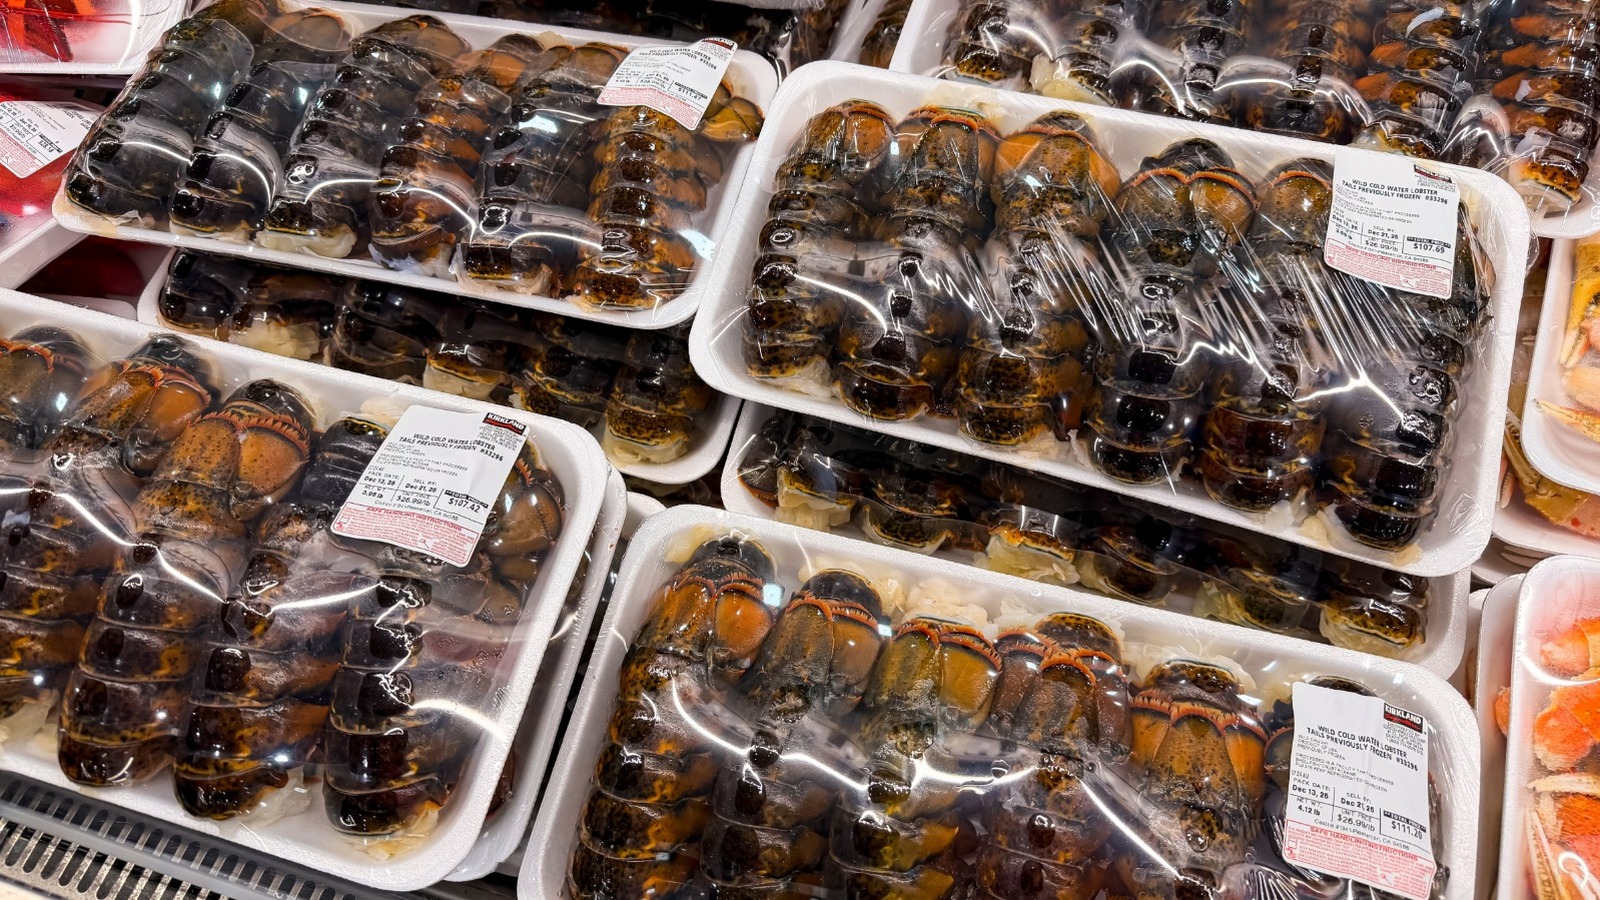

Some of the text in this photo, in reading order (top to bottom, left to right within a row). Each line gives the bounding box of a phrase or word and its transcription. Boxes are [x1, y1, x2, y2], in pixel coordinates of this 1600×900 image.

[691, 50, 711, 61] LOBSTER
[1342, 180, 1357, 190] TAILS
[1358, 186, 1396, 197] PREVIOUSLY
[1396, 192, 1421, 200] FROZEN
[1425, 195, 1448, 205] #33296
[1352, 179, 1438, 196] WILD COLD WATER LOBSTER
[1413, 243, 1445, 254] $107.69
[488, 412, 524, 430] KIRKLAND
[399, 436, 416, 445] TAILS
[416, 440, 454, 449] PREVIOUSLY
[453, 443, 478, 451] FROZEN
[480, 448, 504, 462] #33296
[413, 433, 430, 441] WILD
[447, 437, 469, 445] WATER
[469, 439, 496, 451] LOBSTER
[363, 475, 377, 483] Dec
[448, 498, 481, 514] $107.42
[415, 512, 462, 525] INSTRUCTIONS
[1385, 704, 1422, 725] KIRKLAND
[1306, 727, 1325, 739] TAILS
[1326, 734, 1369, 751] PREVIOUSLY
[1370, 745, 1392, 761] FROZEN
[1396, 757, 1418, 772] #33296
[1317, 724, 1408, 760] WILD COLD WATER LOBSTER
[1292, 784, 1307, 793] Dec
[1308, 789, 1318, 798] 13,
[1312, 782, 1331, 791] DATE:
[1340, 797, 1355, 806] Dec
[1346, 792, 1361, 800] SELL
[1298, 804, 1321, 816] 4.12 lb
[1337, 813, 1376, 832] $26.99/lb
[1391, 820, 1423, 840] $111.20
[1309, 825, 1419, 862] SAFE HANDLING INSTRUCTIONS
